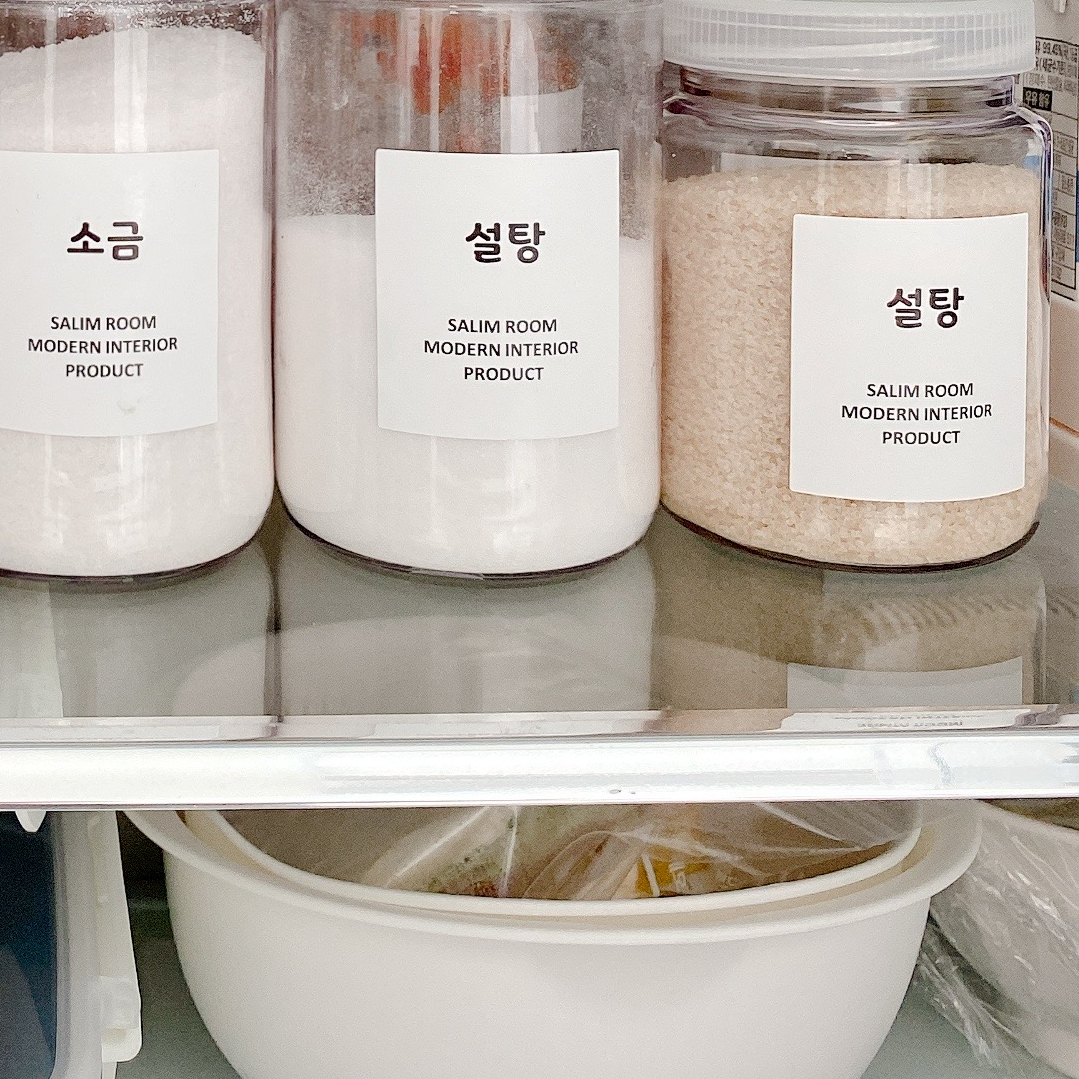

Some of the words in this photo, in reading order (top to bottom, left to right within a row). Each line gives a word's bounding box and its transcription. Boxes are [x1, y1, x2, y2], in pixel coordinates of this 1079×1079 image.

[67, 222, 143, 260] 소금
[466, 223, 545, 263] 설탕
[887, 287, 964, 328] 설탕
[51, 317, 100, 330] SALIM
[106, 316, 156, 330] ROOM
[448, 319, 500, 333] SALIM
[506, 319, 556, 333] ROOM
[29, 339, 100, 354] MODERN
[106, 338, 177, 353] INTERIOR
[425, 340, 500, 356] MODERN
[506, 341, 578, 356] INTERIOR
[66, 364, 143, 377] PRODUCT
[465, 367, 544, 380] PRODUCT
[867, 384, 919, 397] SALIM
[925, 383, 973, 397] ROOM
[842, 406, 919, 421] MODERN
[925, 404, 991, 420] INTERIOR
[883, 431, 960, 444] PRODUCT
